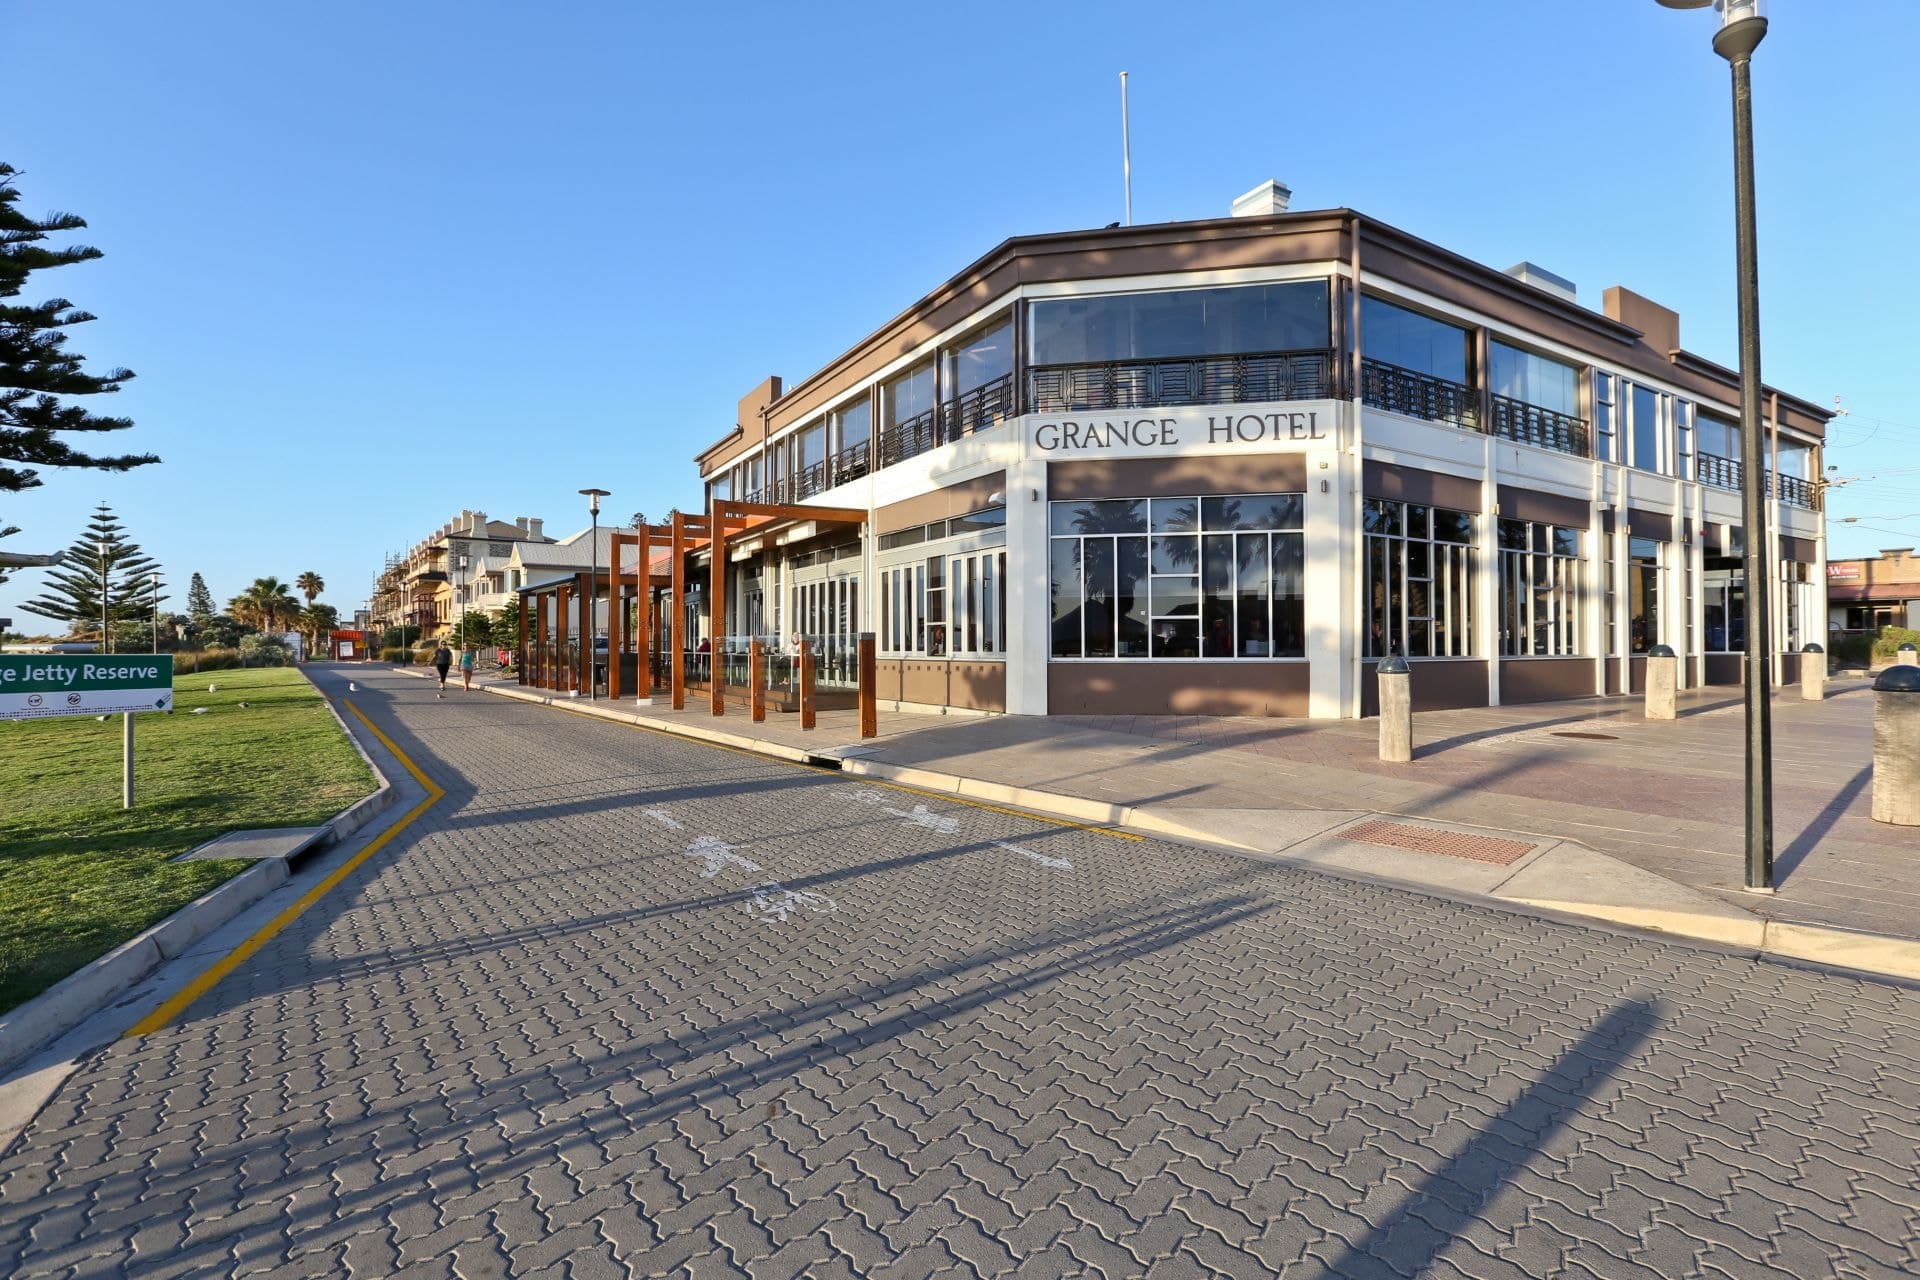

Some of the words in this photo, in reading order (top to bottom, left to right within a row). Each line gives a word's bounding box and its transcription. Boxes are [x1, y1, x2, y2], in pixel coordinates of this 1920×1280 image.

[1034, 418, 1179, 450] GRANGE
[1207, 412, 1326, 443] HOTEL
[22, 664, 77, 686] Jetty
[83, 664, 158, 680] Reserve
